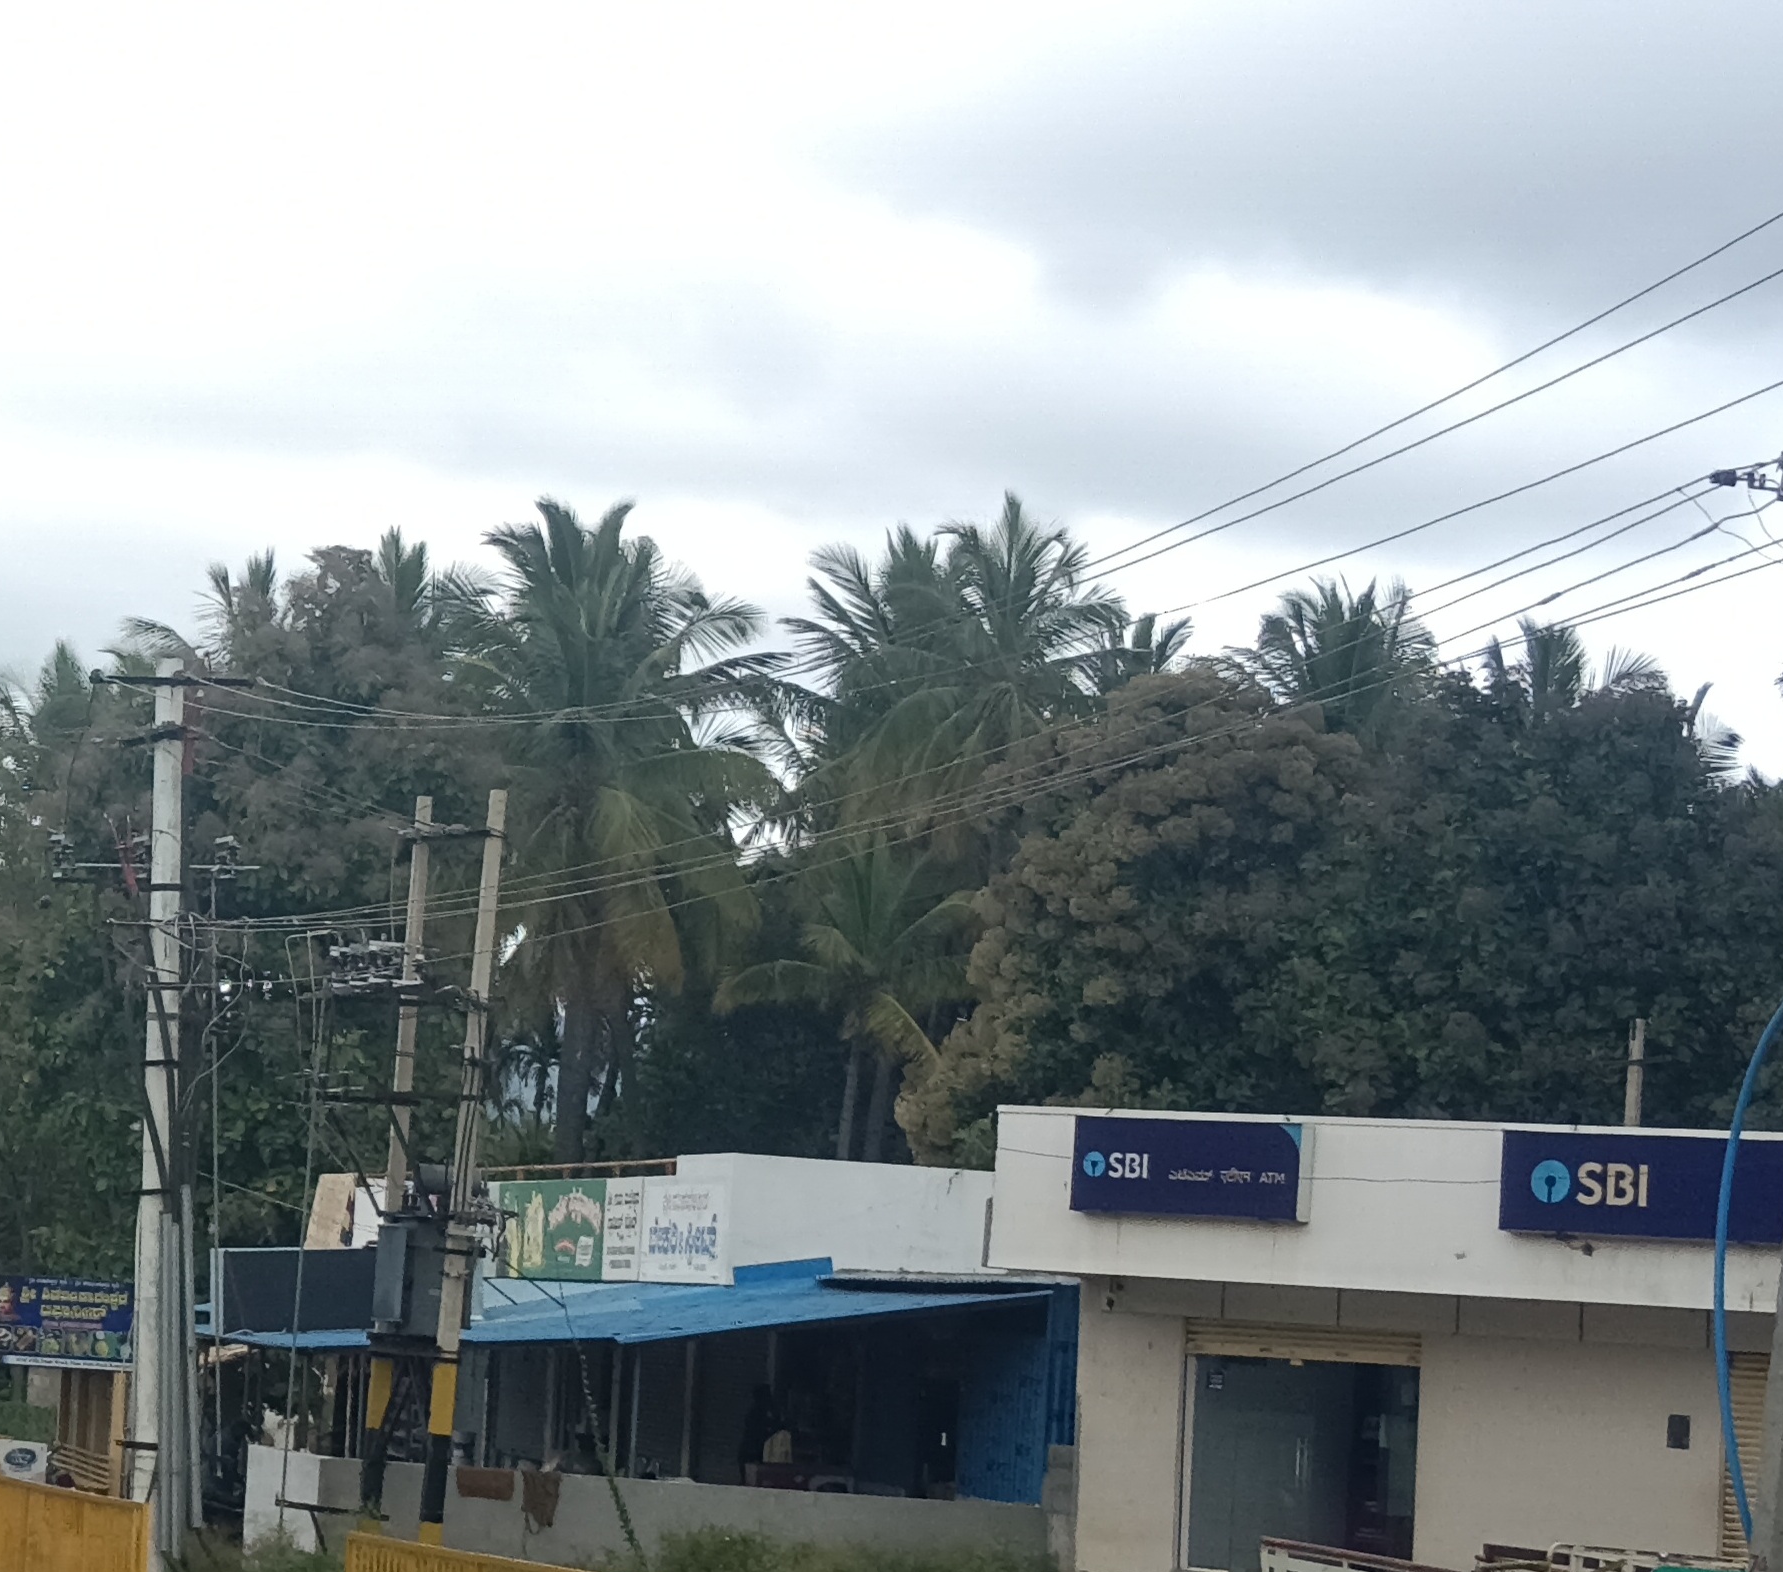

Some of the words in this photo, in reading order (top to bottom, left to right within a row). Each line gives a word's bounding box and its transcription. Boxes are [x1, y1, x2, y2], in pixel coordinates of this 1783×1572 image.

[1108, 1152, 1150, 1179] SBI
[1259, 1172, 1285, 1184] ATM
[1575, 1161, 1650, 1207] SBI
